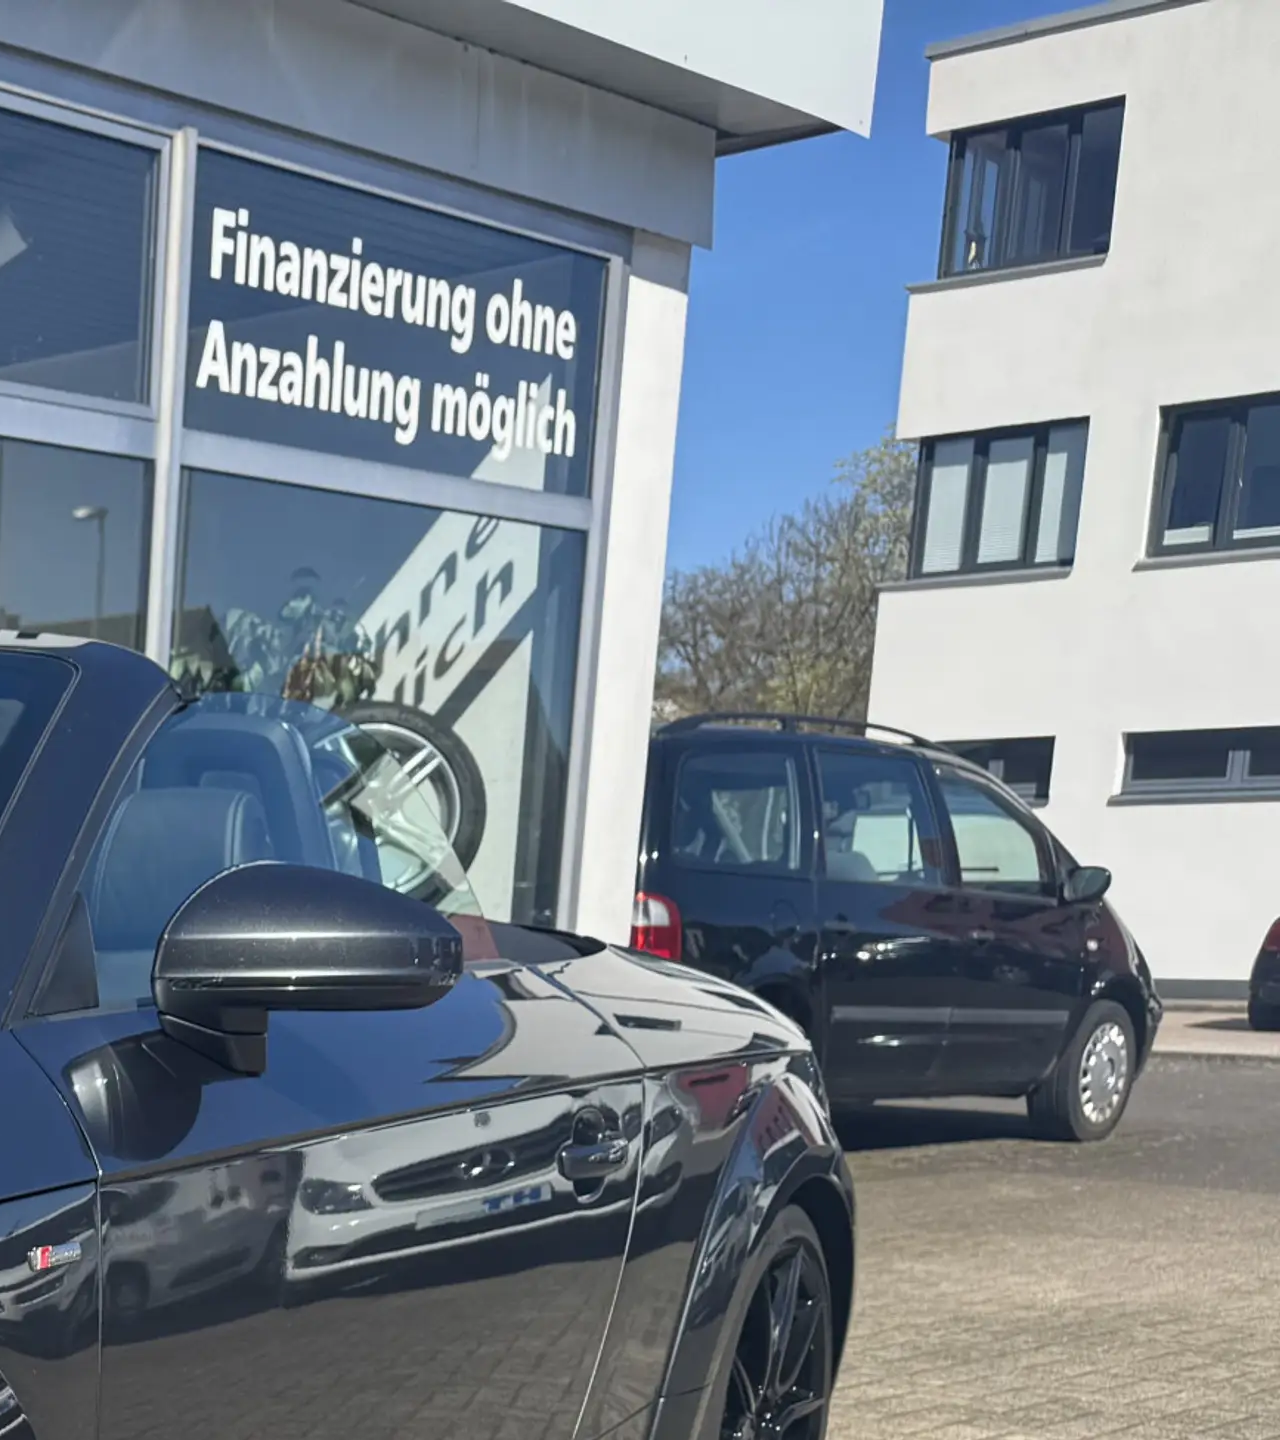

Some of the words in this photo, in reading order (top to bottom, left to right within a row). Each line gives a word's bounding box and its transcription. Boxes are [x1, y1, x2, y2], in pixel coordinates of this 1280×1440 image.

[209, 207, 476, 354] Finanzierung
[485, 278, 577, 360] ohne
[195, 319, 421, 445] Anzahlung
[430, 372, 576, 462] möglich
